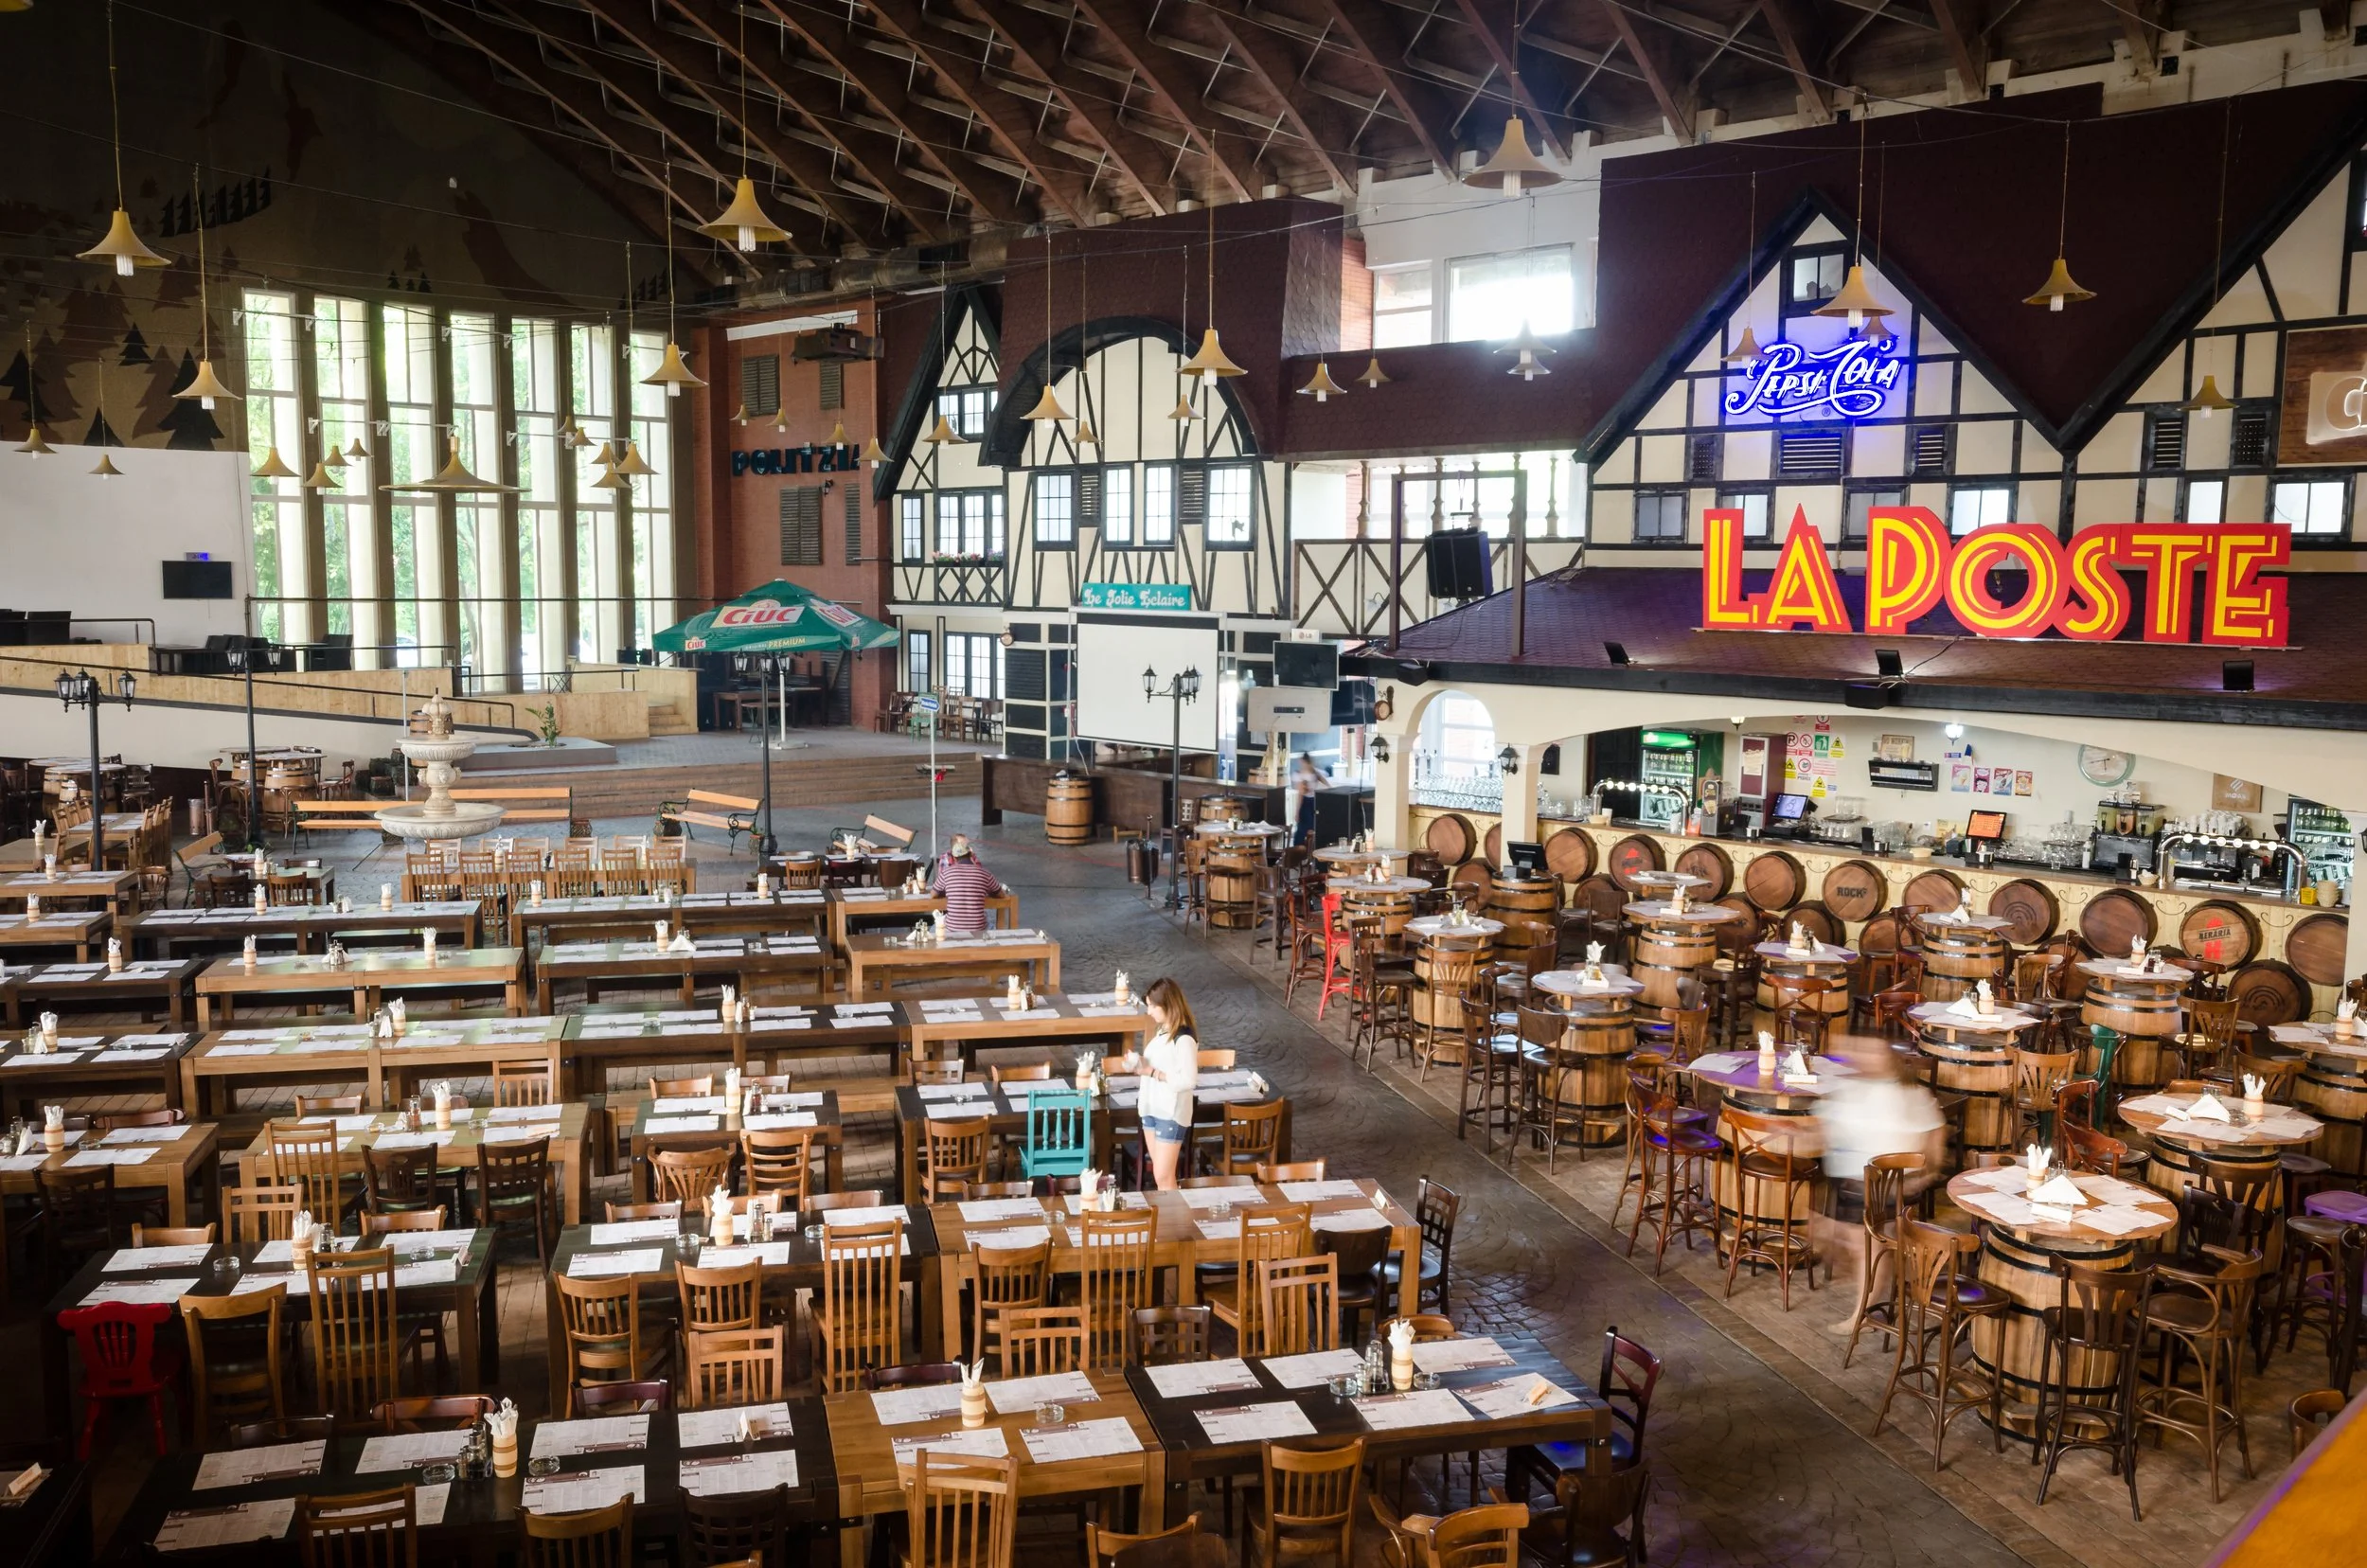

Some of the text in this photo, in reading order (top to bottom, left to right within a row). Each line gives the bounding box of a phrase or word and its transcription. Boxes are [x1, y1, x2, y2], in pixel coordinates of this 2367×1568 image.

[1703, 503, 2293, 648] LA POSTE
[1106, 588, 1135, 608] Jolie
[768, 637, 806, 649] PREMIUM
